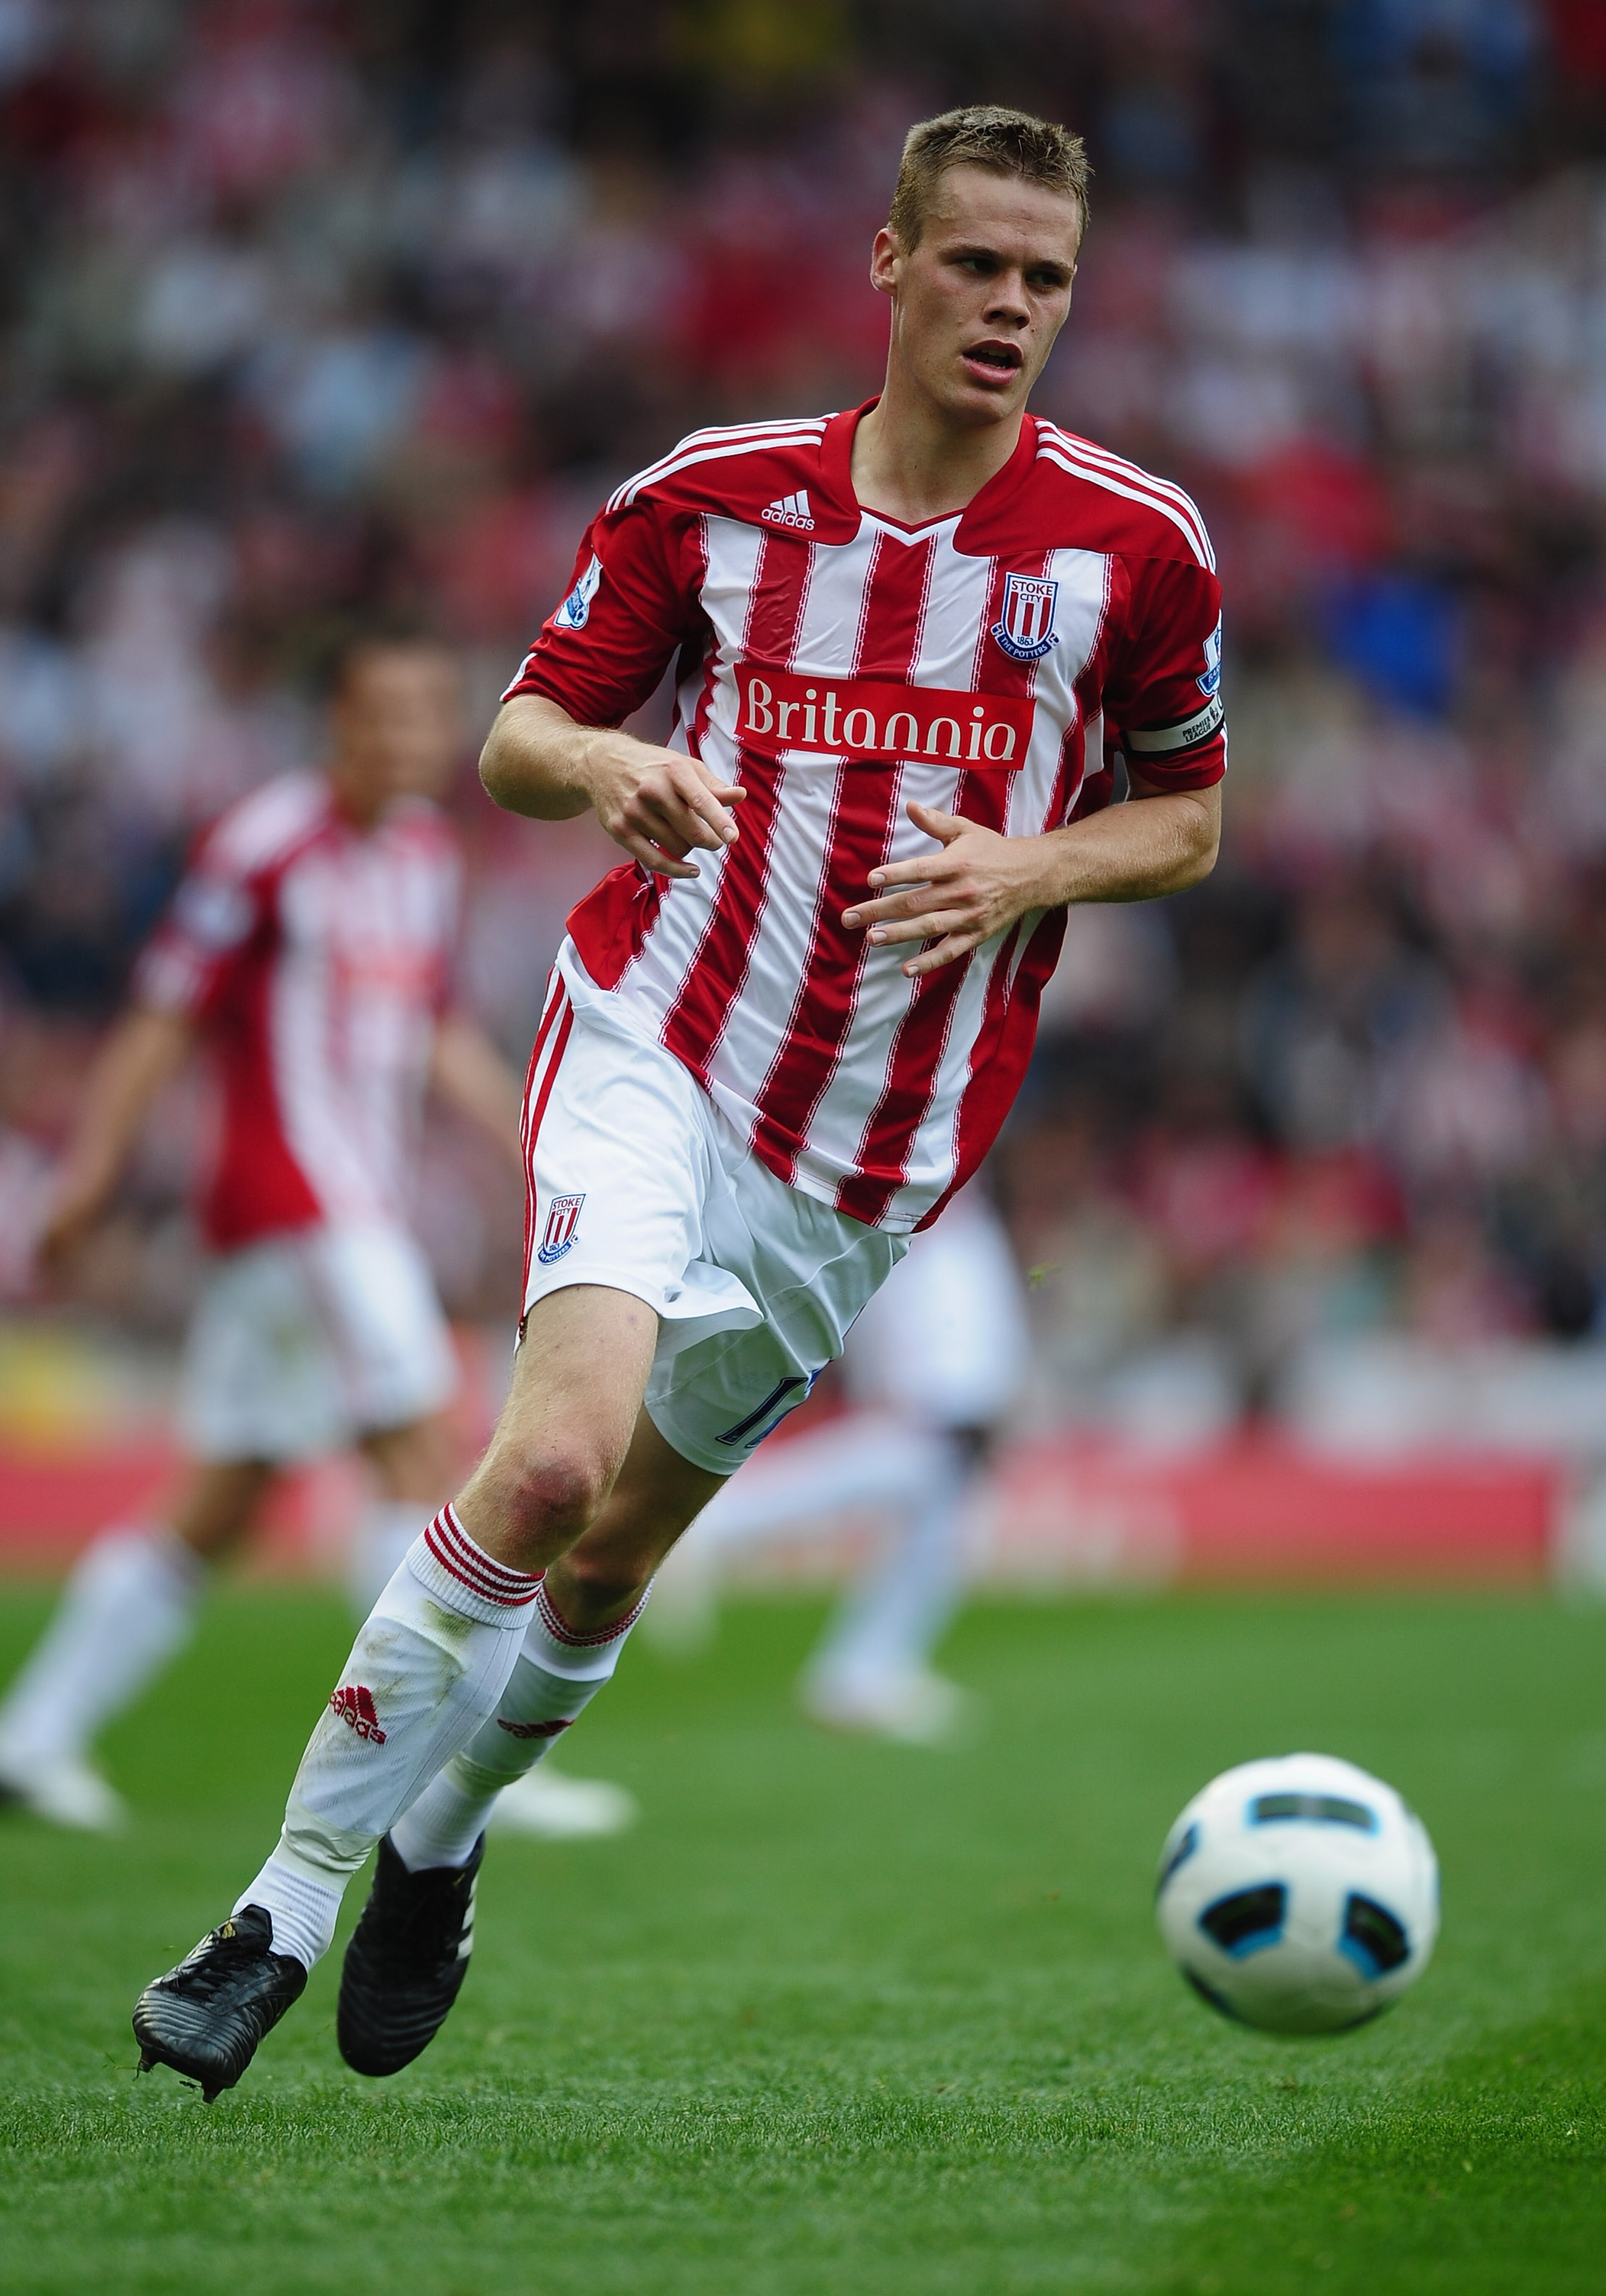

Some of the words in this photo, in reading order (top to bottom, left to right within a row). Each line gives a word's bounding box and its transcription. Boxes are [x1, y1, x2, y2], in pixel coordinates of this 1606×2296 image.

[761, 508, 815, 531] adidas
[1011, 580, 1054, 596] STOKE
[1020, 593, 1042, 602] CITY
[1001, 637, 1014, 652] THE
[1013, 644, 1048, 658] POTTERS
[1017, 636, 1034, 646] 1863
[744, 678, 1017, 760] Britannia
[1182, 716, 1211, 737] PREMIER
[1185, 722, 1211, 742] LEAGUE
[552, 1197, 581, 1210] STOKE
[556, 1207, 571, 1216] CITY
